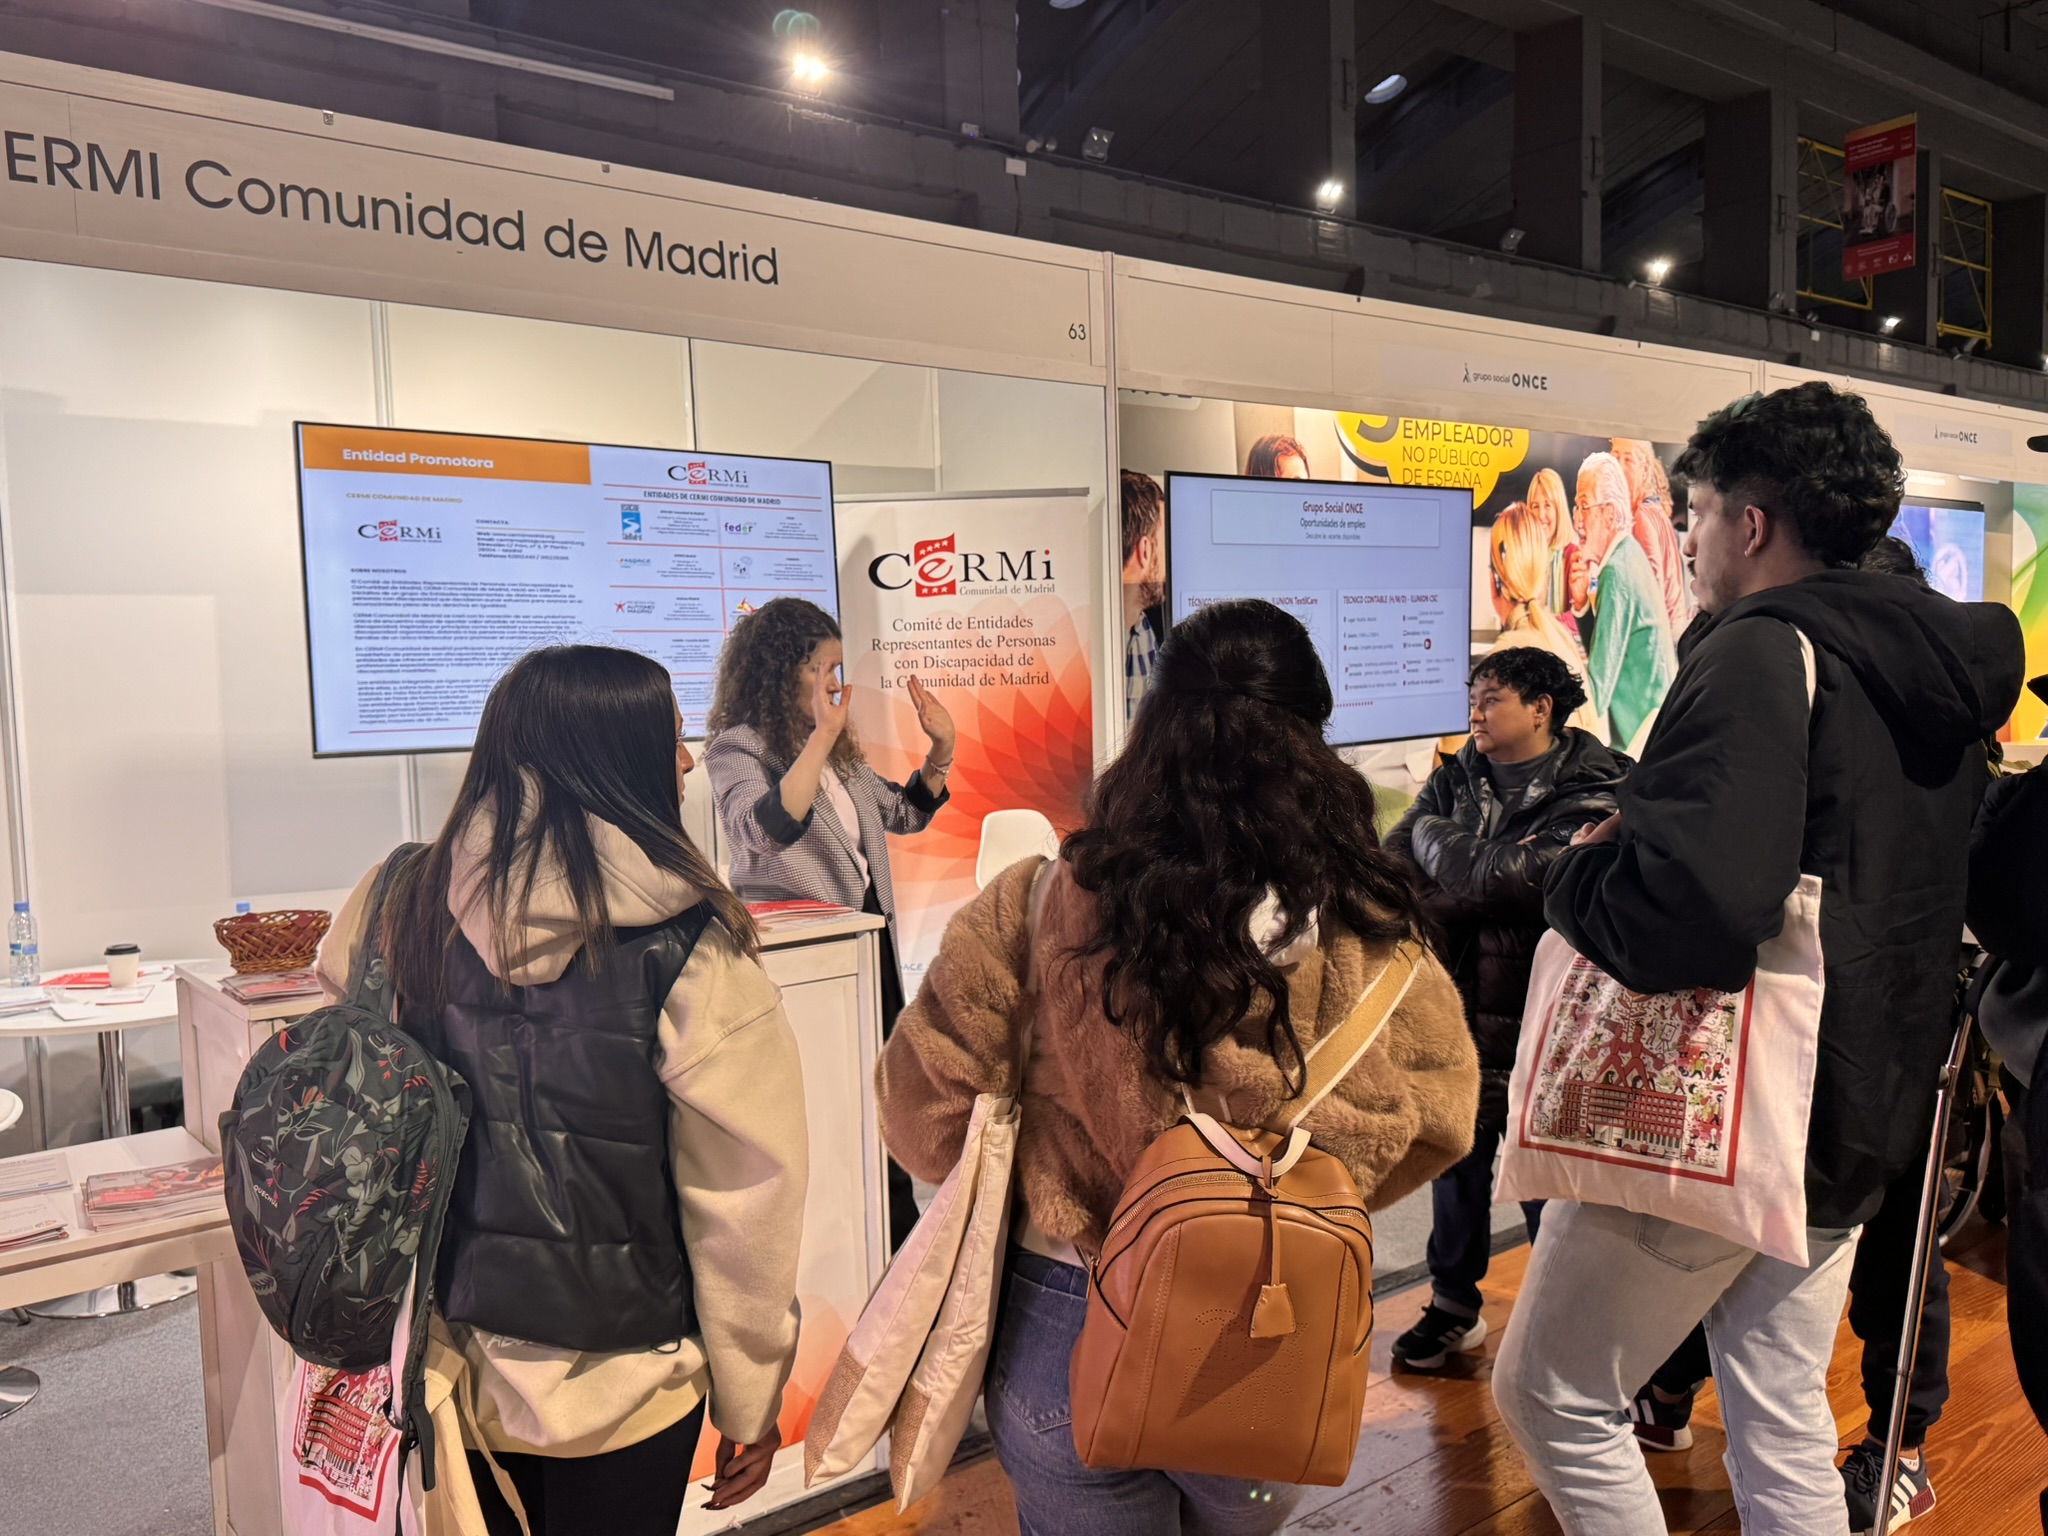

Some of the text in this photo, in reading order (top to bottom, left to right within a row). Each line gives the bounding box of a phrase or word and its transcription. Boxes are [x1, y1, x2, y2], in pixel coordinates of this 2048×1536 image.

[184, 159, 525, 251] Comunidad
[543, 218, 608, 262] de
[626, 228, 779, 285] Madrid
[1068, 323, 1087, 341] 63
[1472, 373, 1548, 391] grupo social ONCE
[1403, 420, 1513, 448] EMPLEADOR
[1959, 431, 1977, 444] ONCE
[343, 449, 494, 469] Entidad Promotora
[1403, 445, 1490, 467] NO PÚBLICO
[1403, 468, 1482, 488] DE ESPAÑA
[643, 491, 679, 499] ENTIDADES
[690, 493, 709, 501] CERMI
[1303, 501, 1363, 516] Grupo Social ONCE
[724, 522, 753, 534] feder
[1300, 518, 1366, 531] Oportunidades de empleo
[959, 584, 1055, 596] Comunidad de Madrid
[892, 615, 1034, 632] Comité de Entidades
[872, 634, 1056, 654] Representantes de Personas
[894, 653, 1034, 671] con Discapacidad de
[880, 671, 1050, 689] la Cmunidad de Madrid
[253, 1184, 279, 1209] QUECHUA
